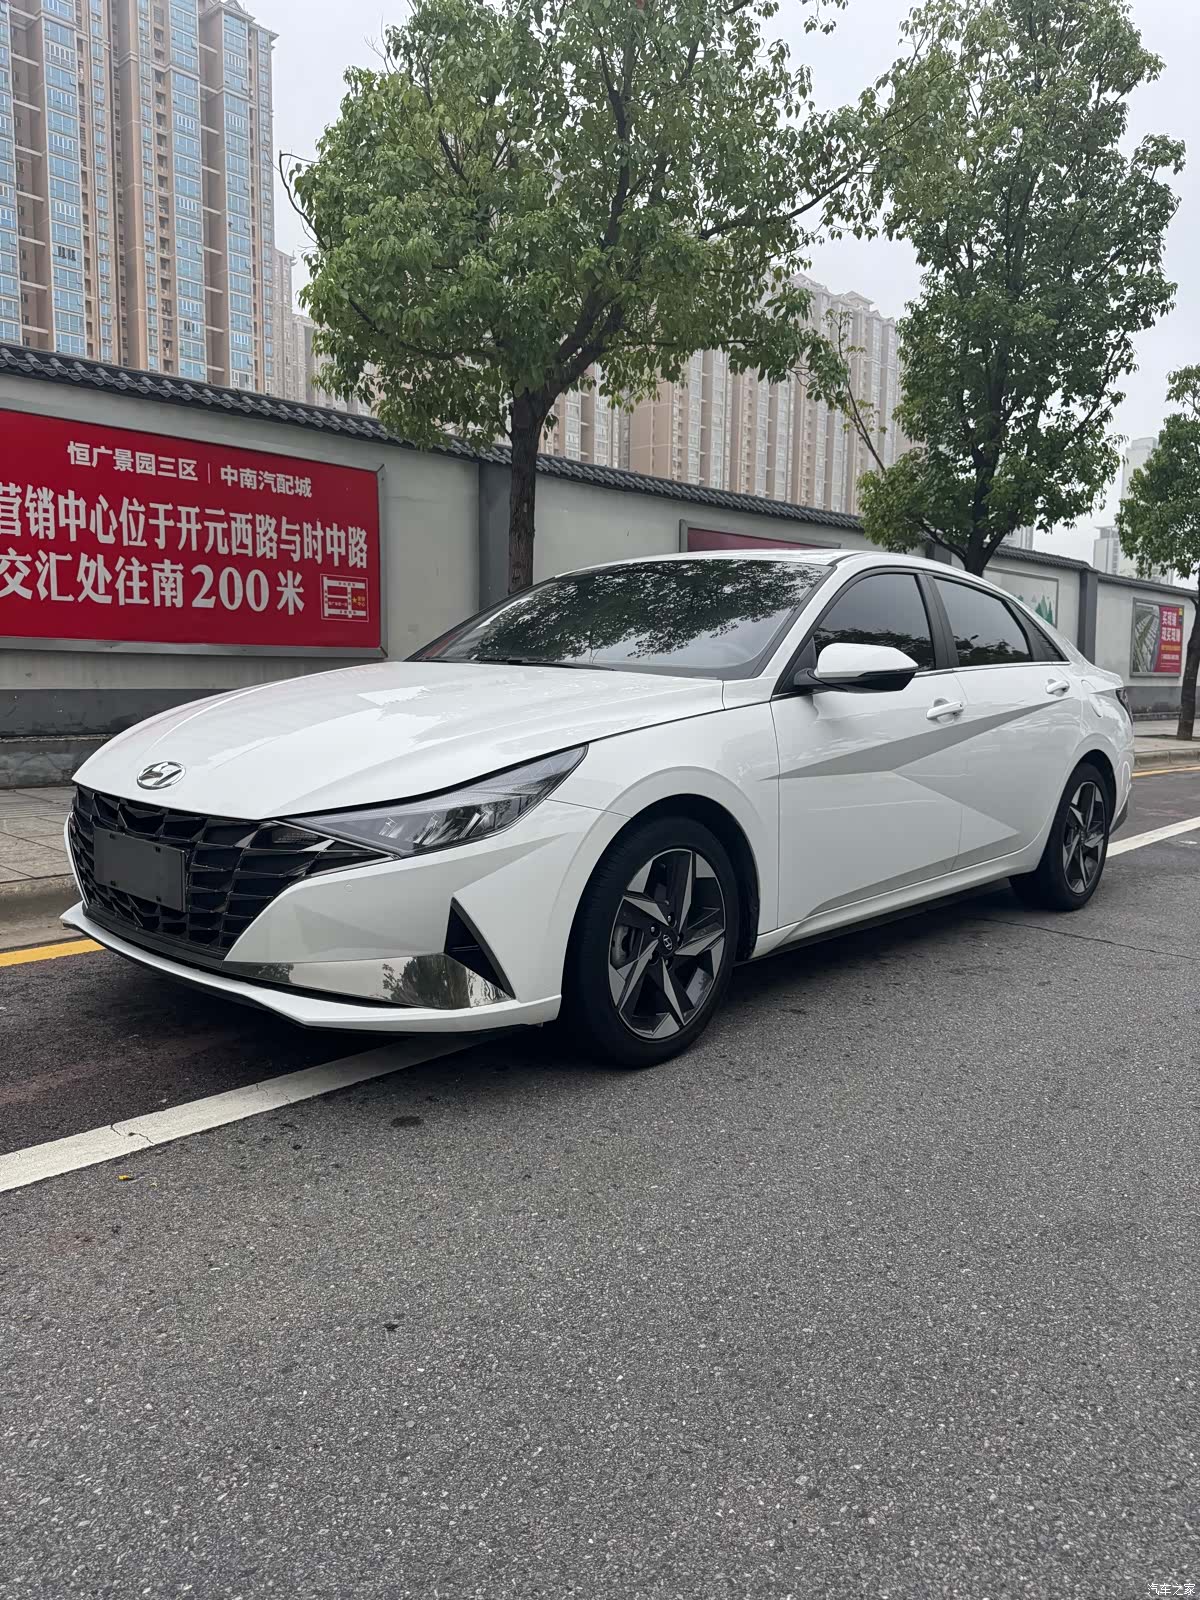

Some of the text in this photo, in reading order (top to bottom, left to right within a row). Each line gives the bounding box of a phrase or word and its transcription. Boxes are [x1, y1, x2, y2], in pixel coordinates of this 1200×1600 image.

[67, 441, 312, 497] 恒广景园三区 中南汽配城
[0, 481, 367, 568] 营销中心位于开元西路与时中路
[0, 547, 304, 616] 交汇处往南200米
